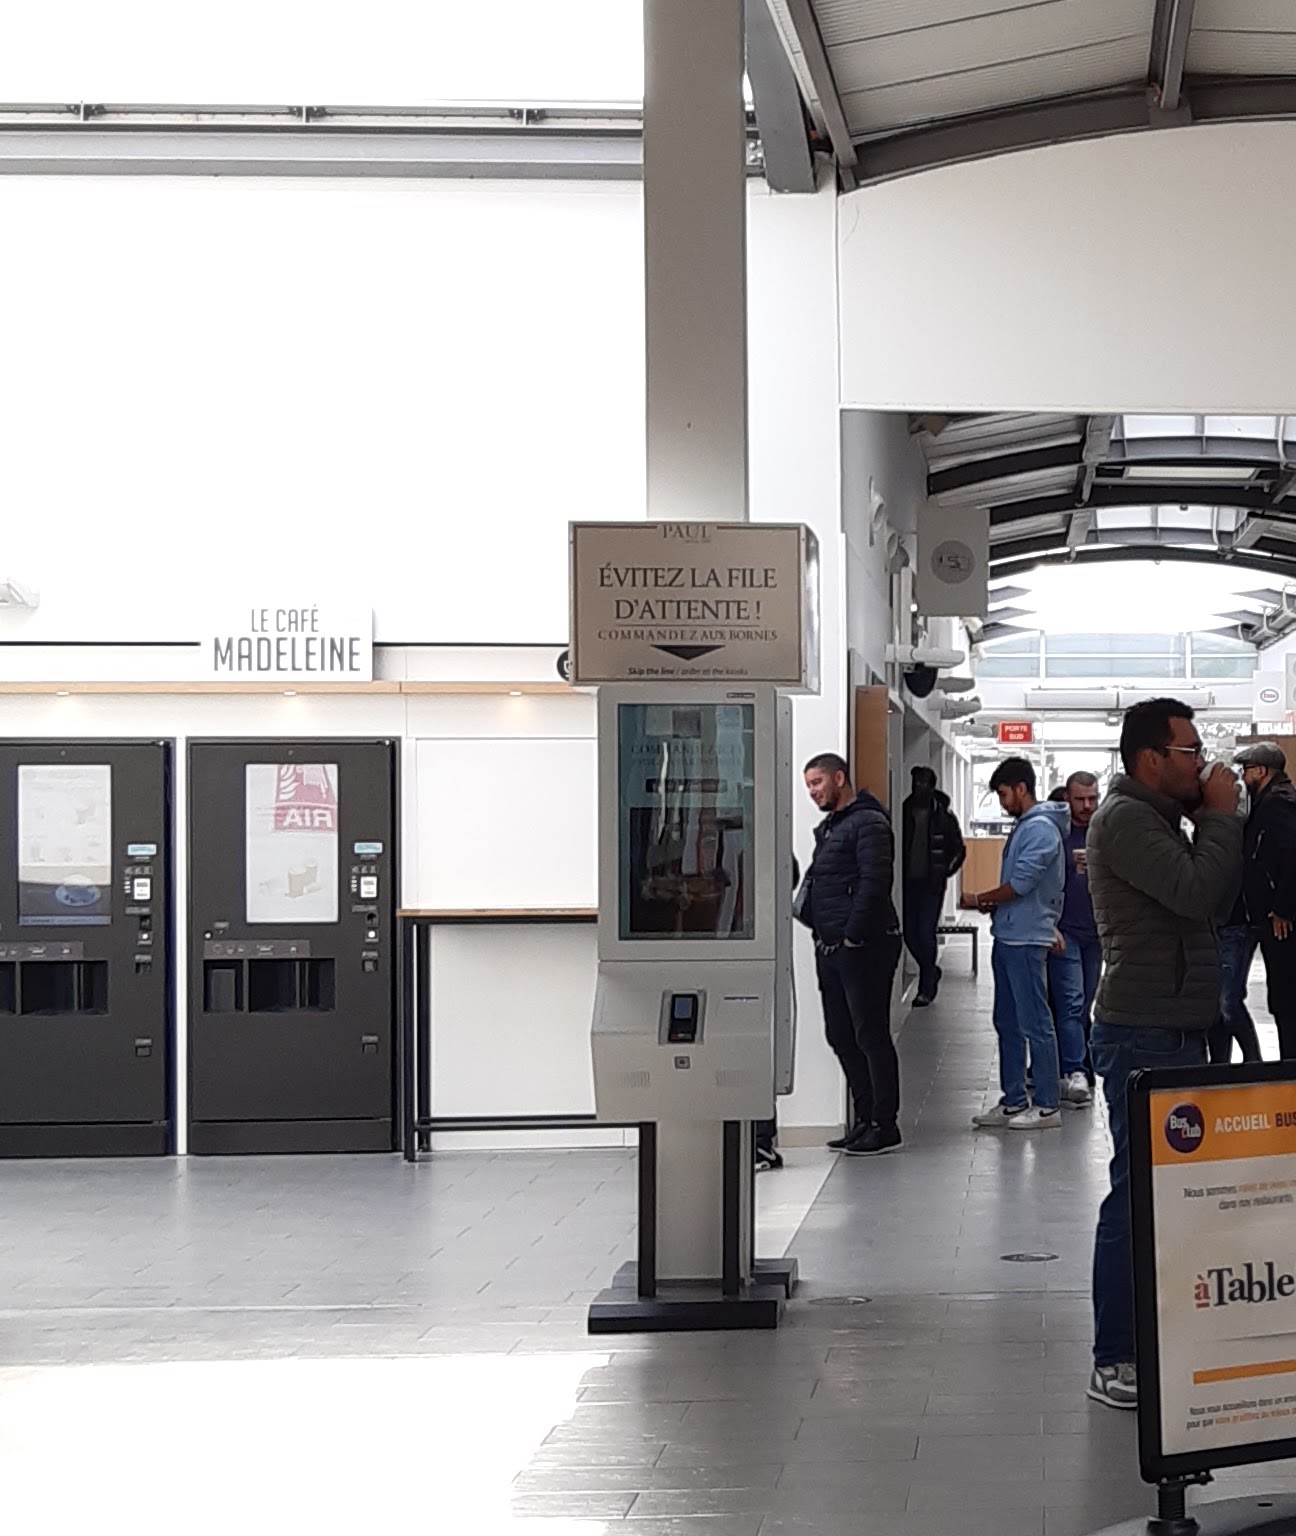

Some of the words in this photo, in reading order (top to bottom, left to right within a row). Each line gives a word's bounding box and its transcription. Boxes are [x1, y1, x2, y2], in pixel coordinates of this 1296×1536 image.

[662, 524, 712, 539] PAUL
[599, 562, 685, 589] ÉVITEZ
[690, 567, 723, 588] LA
[727, 567, 778, 589] FILE
[251, 608, 269, 633] LE
[276, 603, 319, 633] CAFÉ
[614, 599, 750, 621] D'ATTENTE
[597, 629, 699, 641] COMMANDEZ
[700, 629, 727, 641] AUX
[728, 629, 778, 641] BORNES
[213, 636, 361, 672] MADELEINE
[1169, 1114, 1189, 1130] Bus
[1214, 1113, 1271, 1134] ACCUEIL
